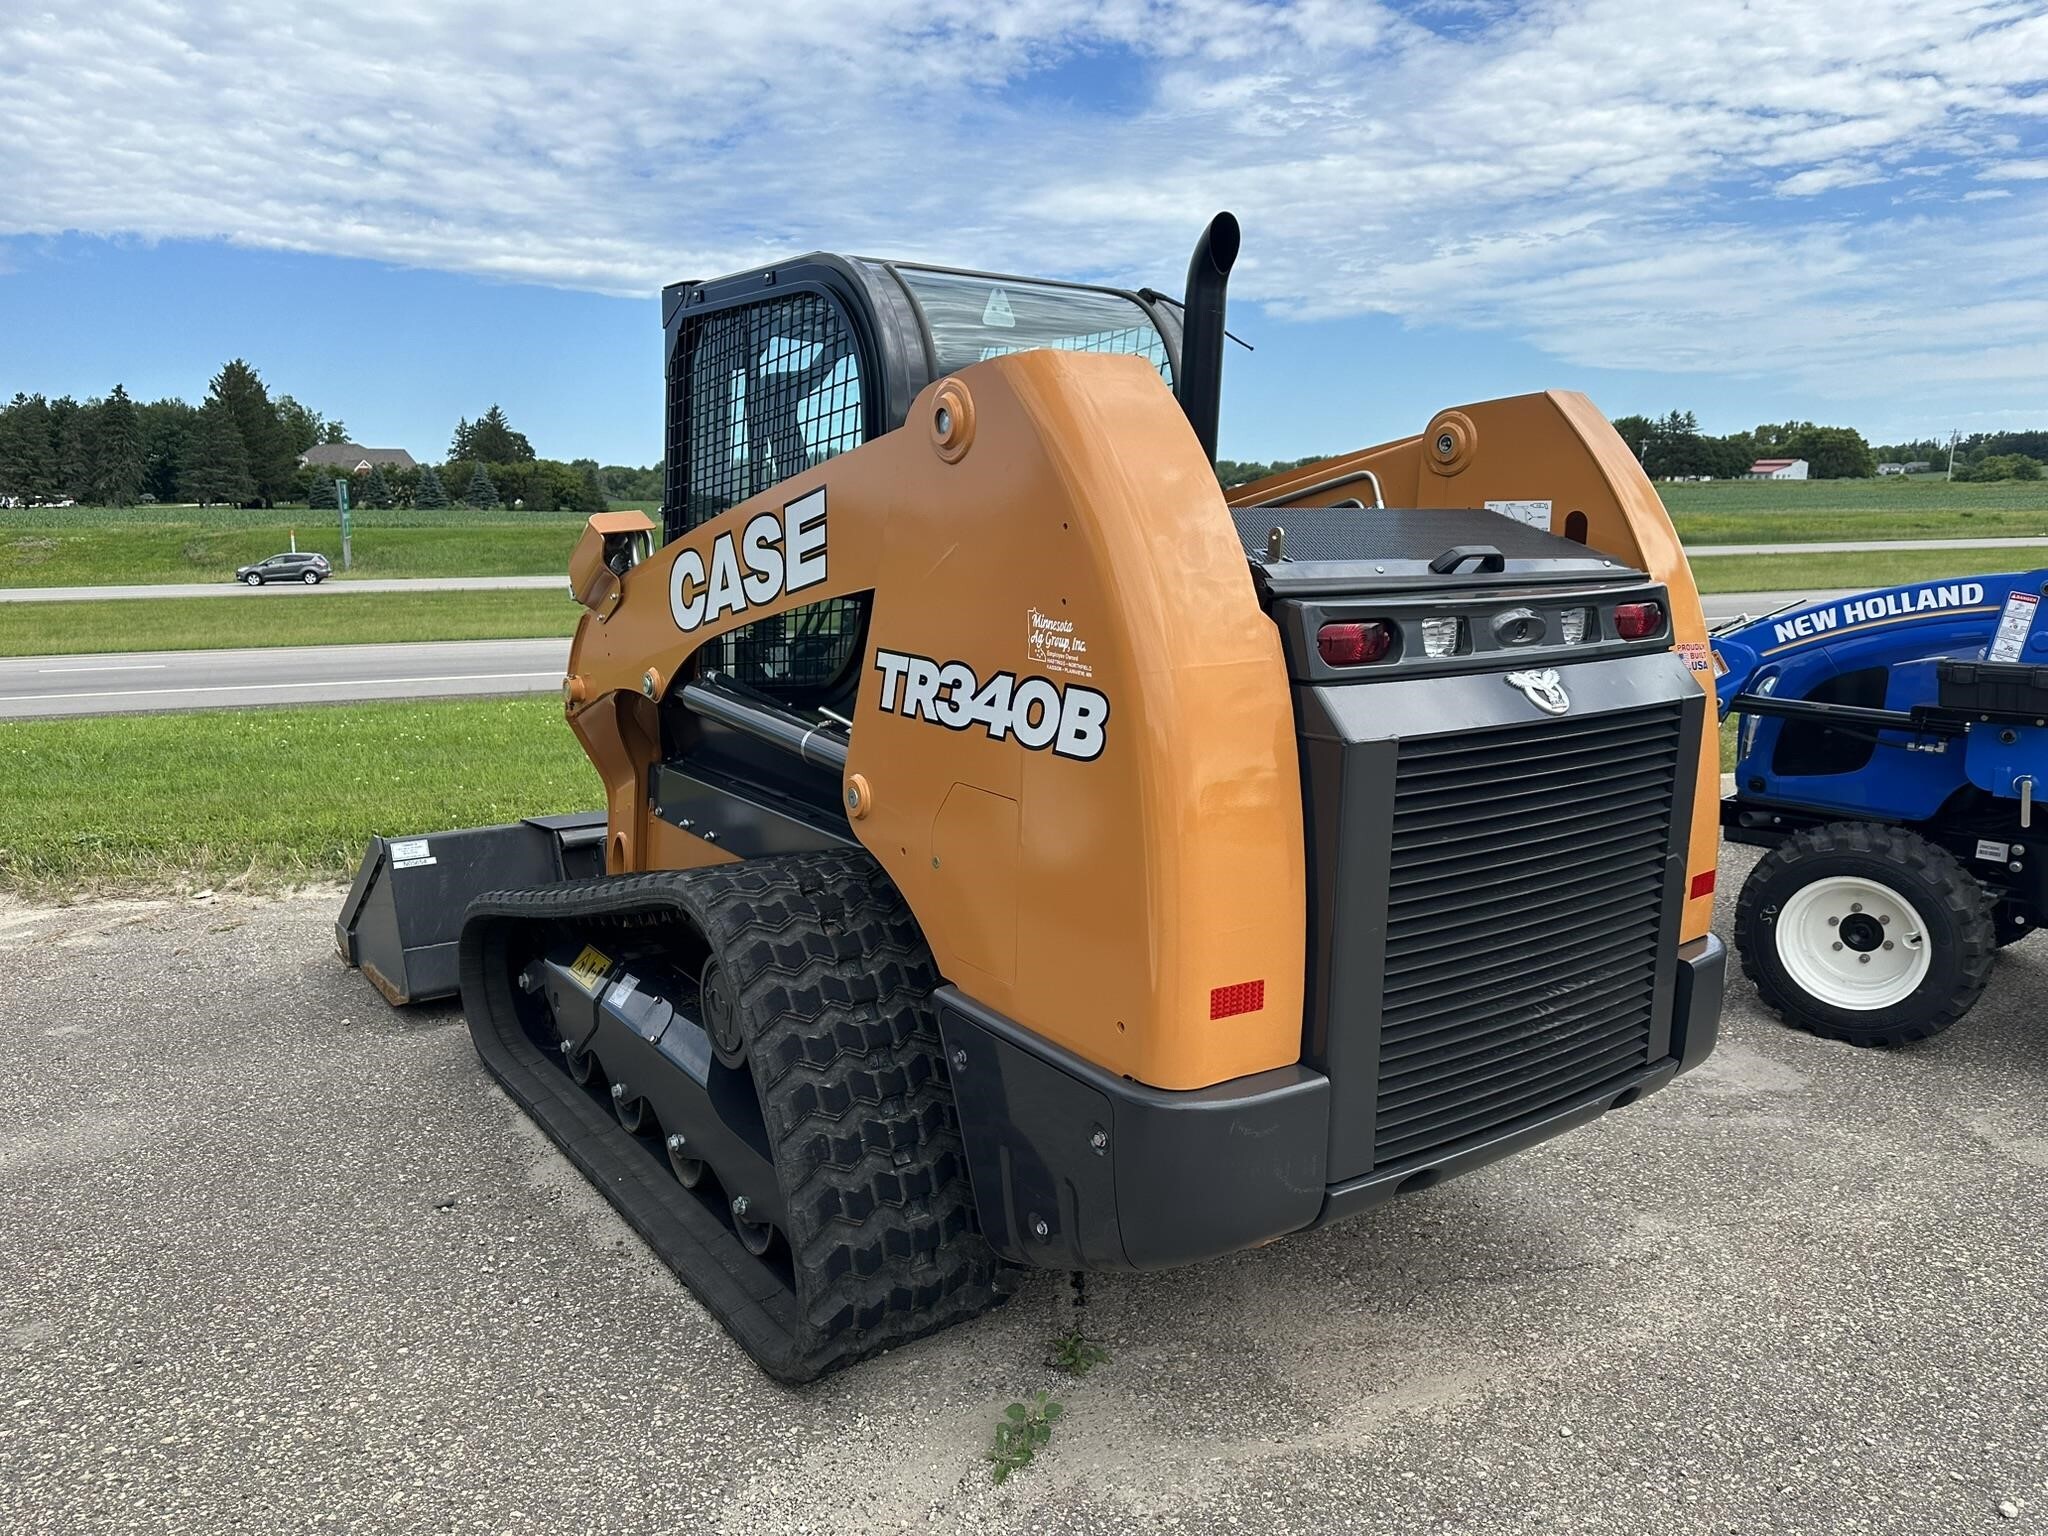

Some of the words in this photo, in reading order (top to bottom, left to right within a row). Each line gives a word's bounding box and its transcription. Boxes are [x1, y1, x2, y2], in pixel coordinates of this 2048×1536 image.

[669, 484, 827, 632] CASE
[1032, 614, 1073, 632] Minnesota
[1774, 607, 1836, 643] NEW
[1843, 583, 1984, 624] HOLLAND
[1031, 629, 1045, 648] Ag
[1045, 632, 1071, 652] Group,
[1072, 637, 1086, 652] Inc.
[1677, 643, 1705, 651] PROUDLY
[1690, 652, 1706, 660] BUILT
[1691, 660, 1709, 671] USA
[875, 648, 1110, 762] TR340B
